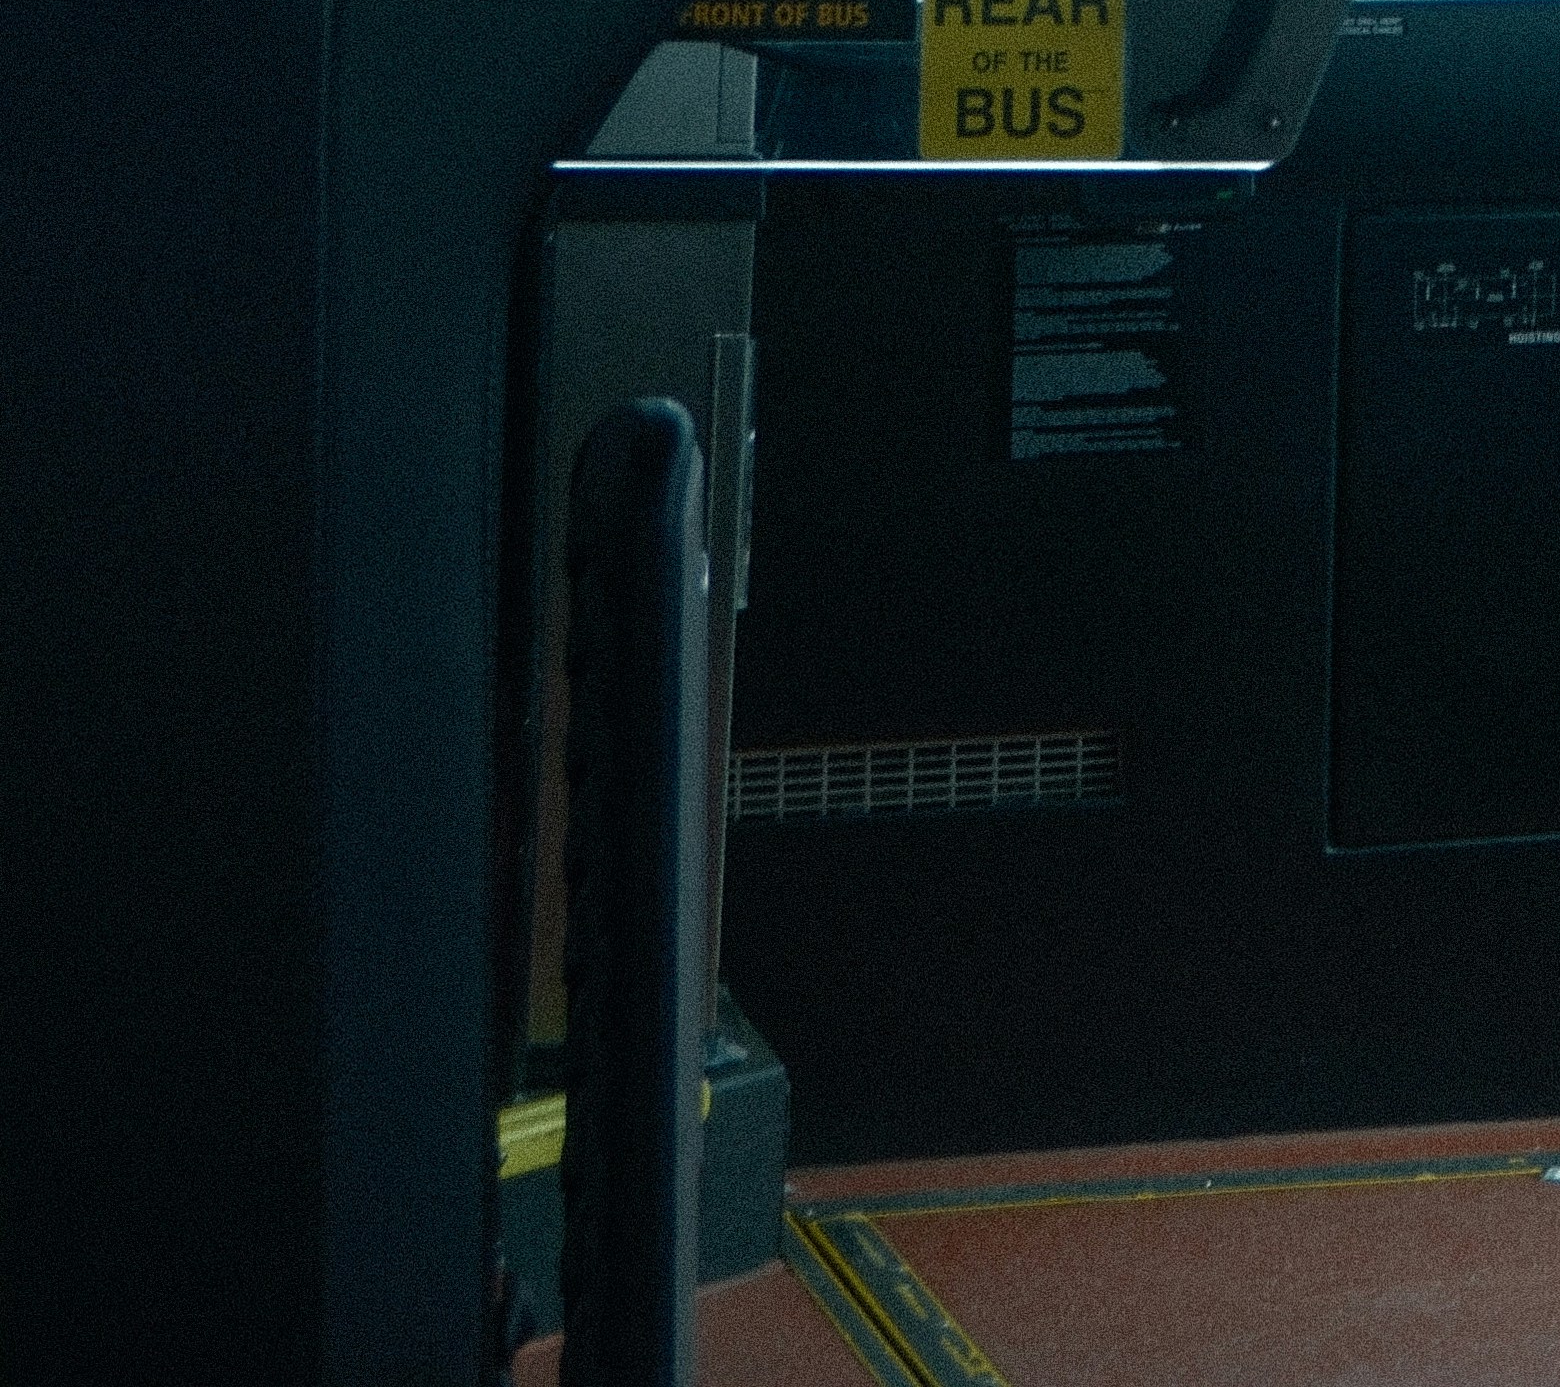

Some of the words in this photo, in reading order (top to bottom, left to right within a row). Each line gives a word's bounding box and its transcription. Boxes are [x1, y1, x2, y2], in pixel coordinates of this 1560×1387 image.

[773, 2, 809, 28] OF
[815, 2, 872, 28] BUS
[971, 48, 1011, 73] OF
[1019, 48, 1070, 73] THE
[955, 86, 1087, 140] BUS
